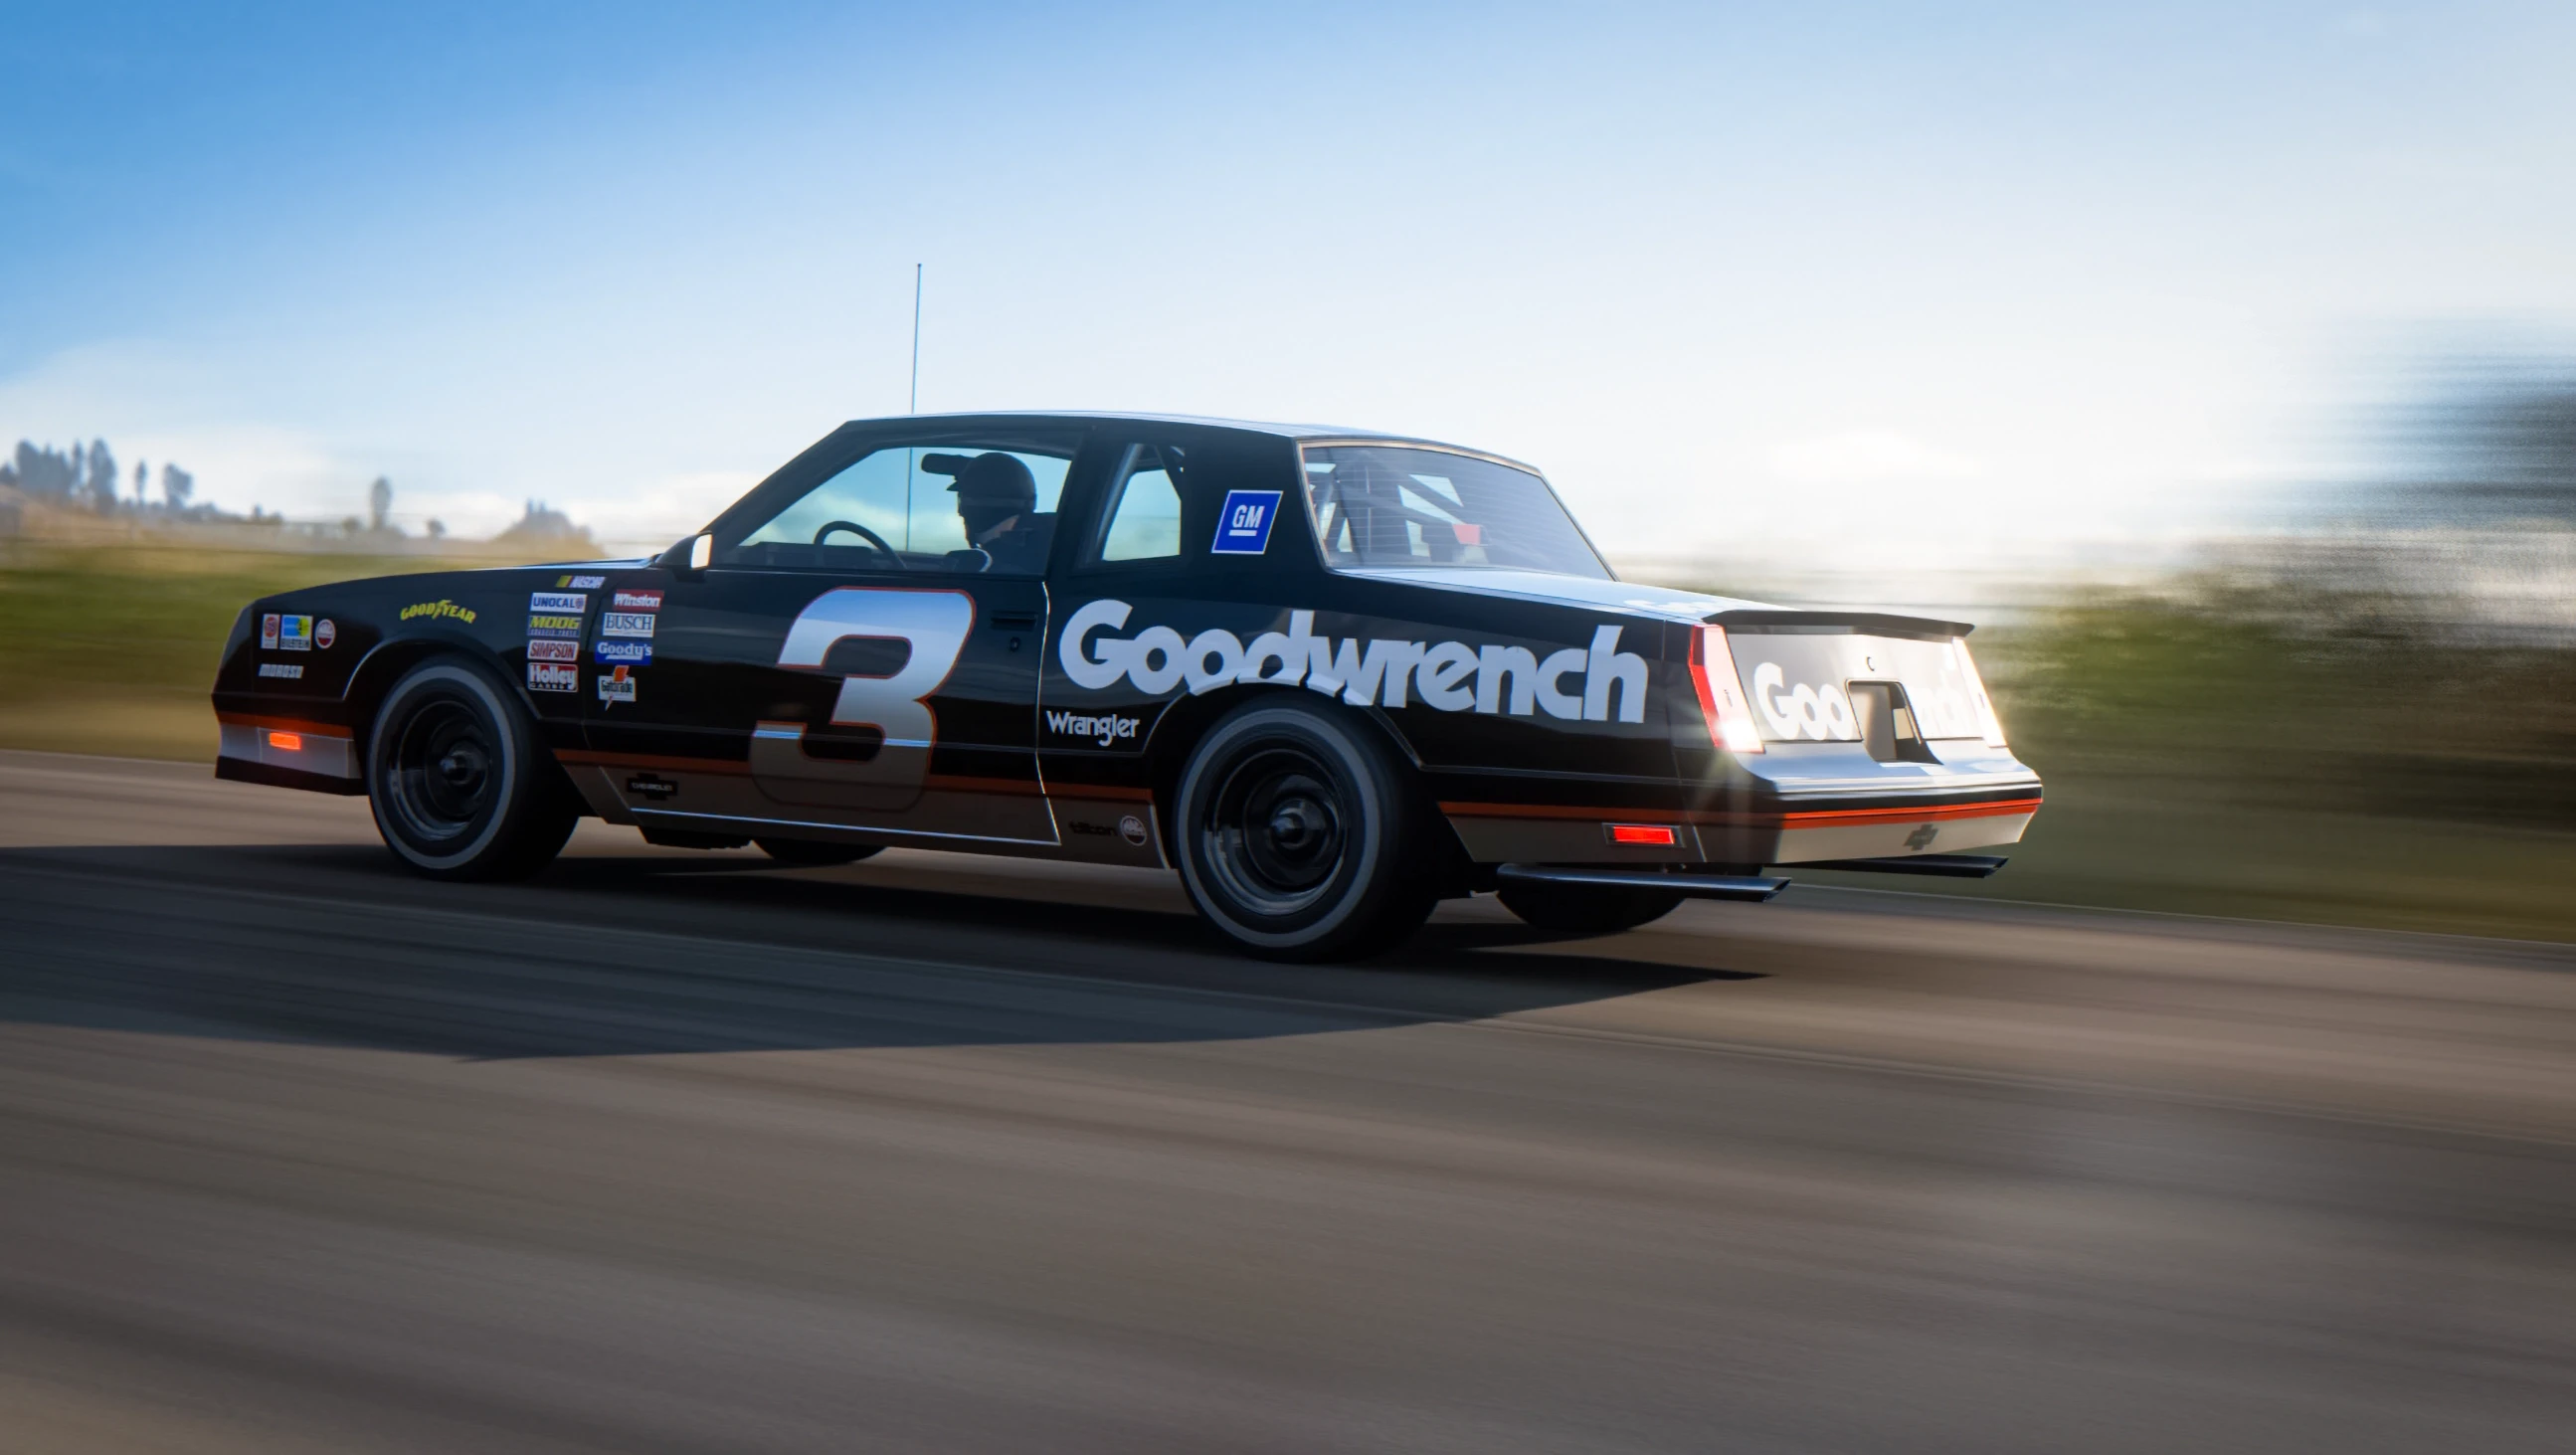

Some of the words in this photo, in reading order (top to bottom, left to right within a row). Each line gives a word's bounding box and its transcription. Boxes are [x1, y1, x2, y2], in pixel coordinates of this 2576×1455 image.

[1231, 504, 1265, 529] GM
[533, 597, 575, 609] UNOCAL
[613, 593, 661, 608] Winston
[400, 600, 476, 624] GOODYEAR
[530, 617, 580, 630] MOOG
[606, 615, 652, 631] BUSCH
[530, 641, 576, 658] SIMPSON
[597, 641, 653, 660] Goody's
[1058, 599, 1650, 724] Goodwrench
[529, 664, 575, 690] Holley
[749, 586, 978, 812] 3
[1046, 710, 1141, 747] Wrangler
